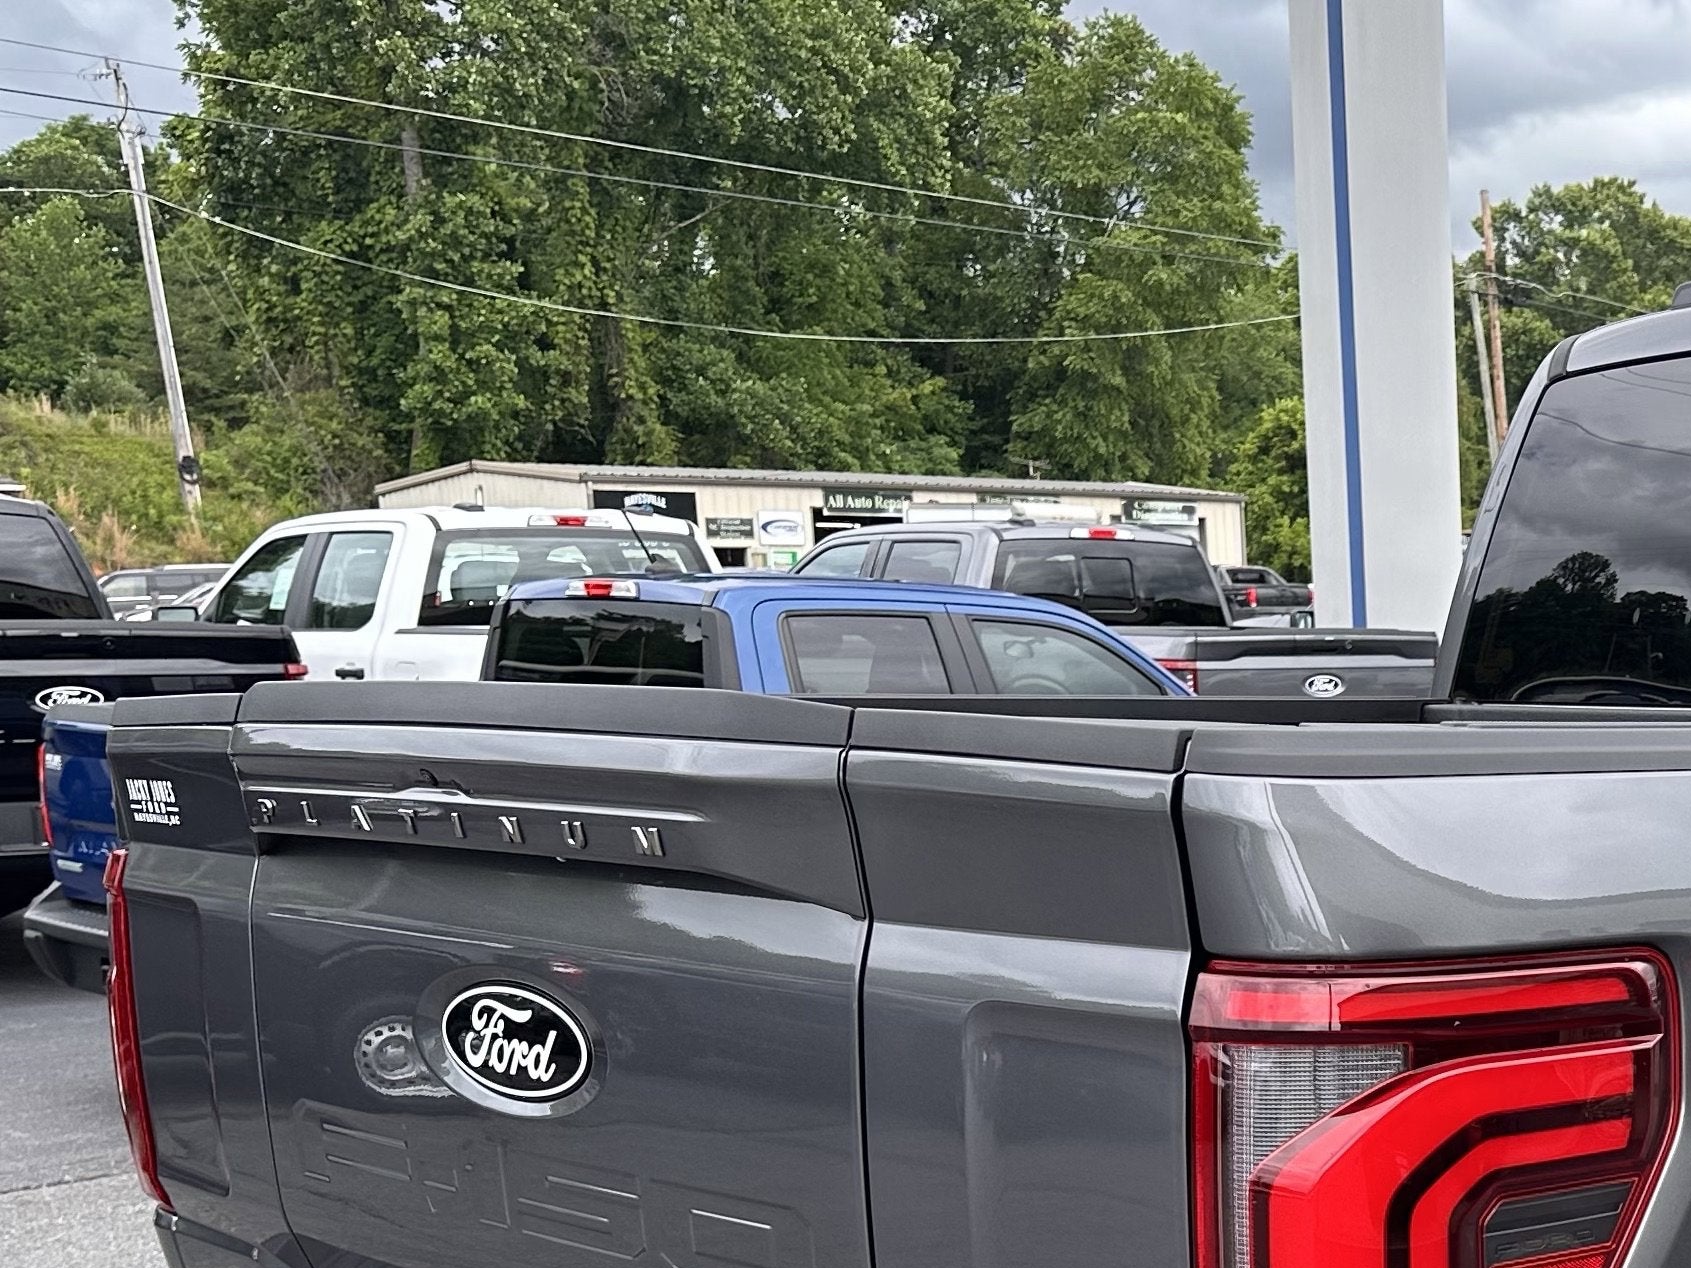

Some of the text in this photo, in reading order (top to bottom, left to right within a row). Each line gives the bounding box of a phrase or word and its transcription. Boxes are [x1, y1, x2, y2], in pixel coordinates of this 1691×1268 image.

[826, 494, 844, 508] All
[845, 495, 873, 509] Auto
[256, 798, 666, 857] PLATINUM
[464, 998, 558, 1083] Ford
